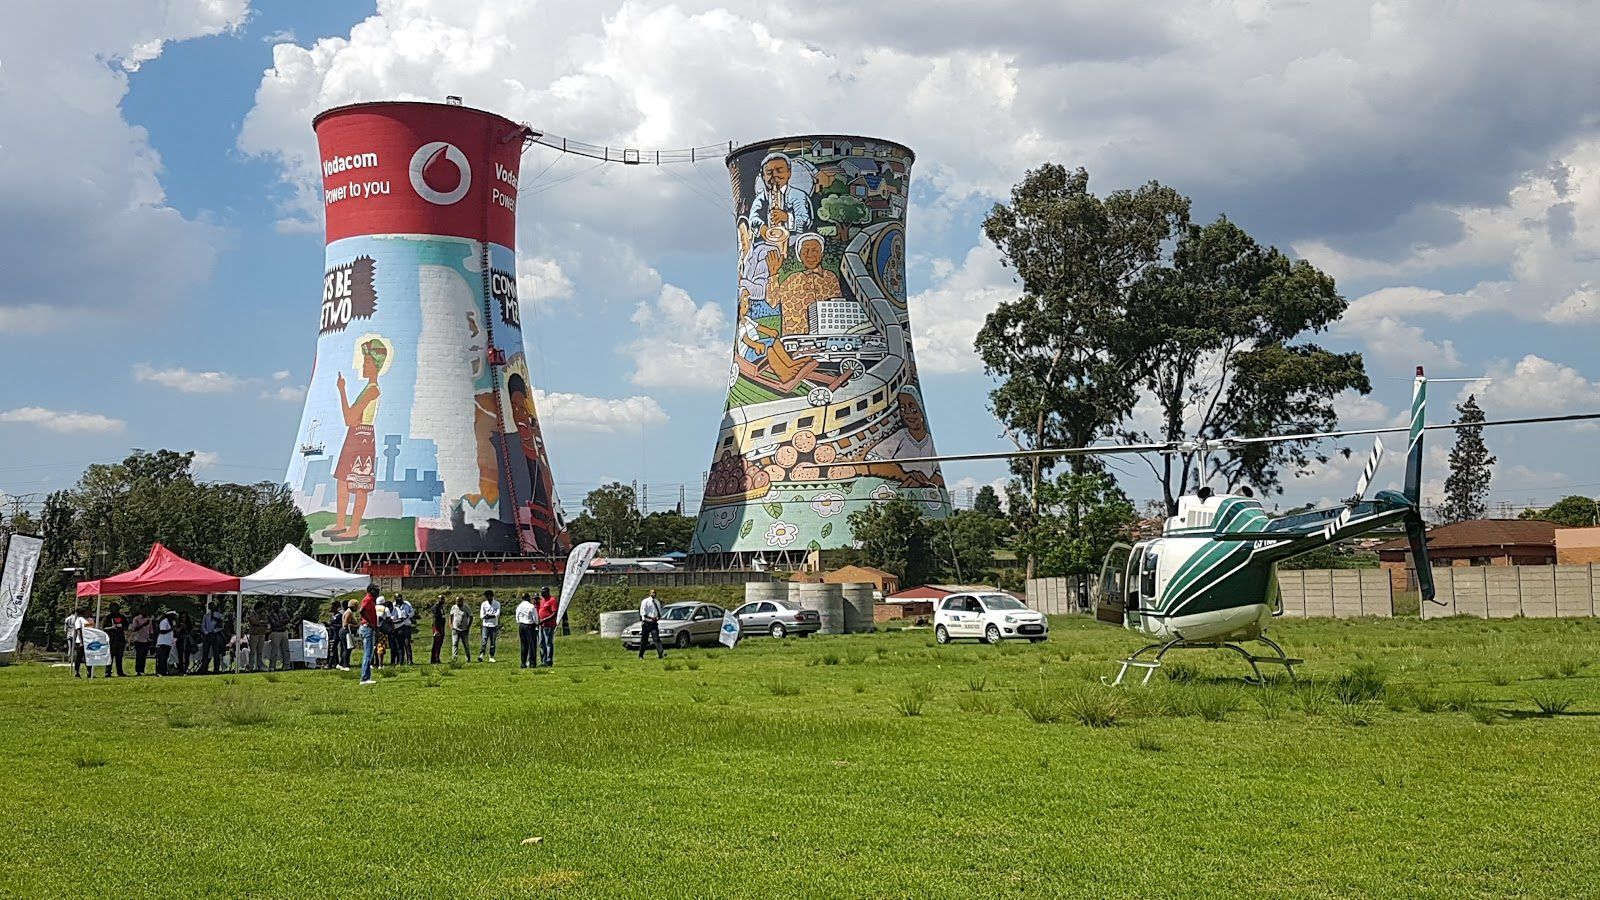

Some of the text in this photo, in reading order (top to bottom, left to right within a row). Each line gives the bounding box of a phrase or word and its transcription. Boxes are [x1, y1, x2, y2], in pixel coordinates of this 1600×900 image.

[323, 153, 377, 178] Vodacom
[325, 181, 390, 206] Power to you
[335, 268, 353, 298] BE
